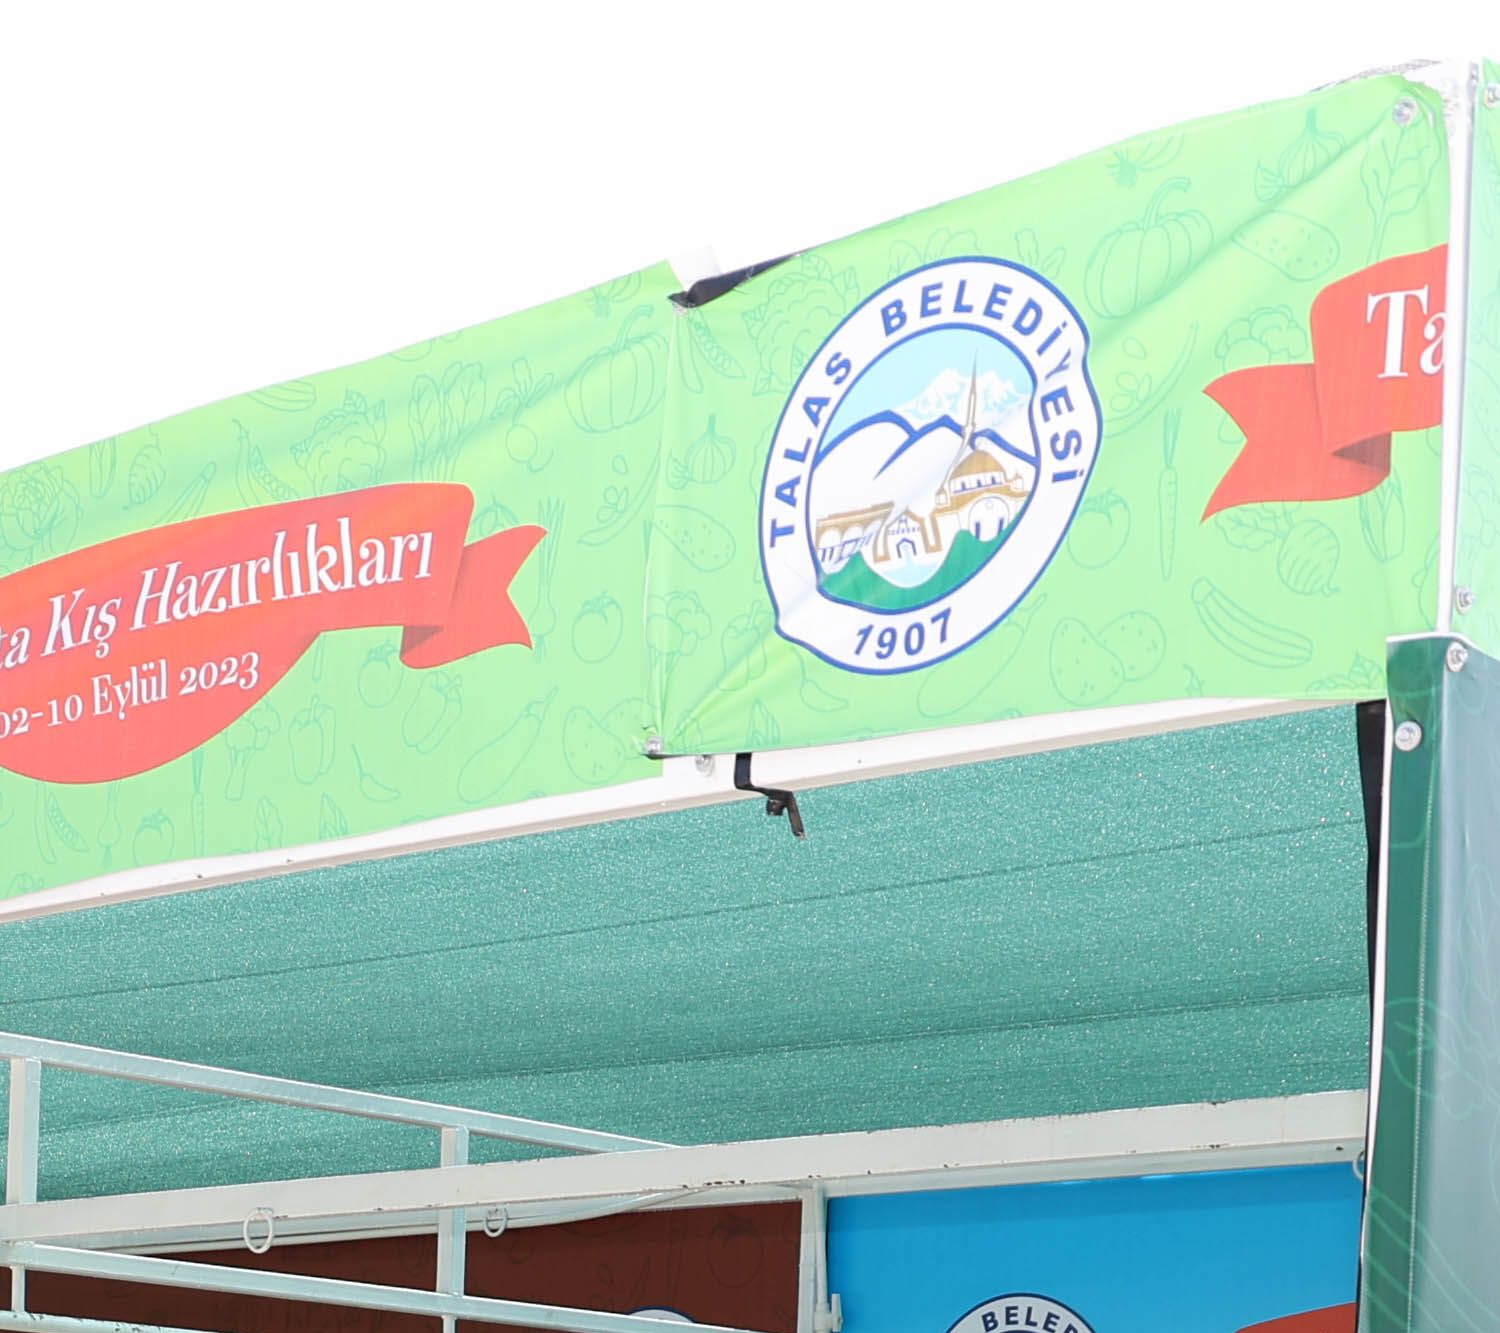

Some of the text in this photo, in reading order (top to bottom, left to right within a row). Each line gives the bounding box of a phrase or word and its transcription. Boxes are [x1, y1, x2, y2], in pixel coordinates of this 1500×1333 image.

[770, 278, 1086, 548] TALAS BELEDİYESİ
[41, 587, 123, 660] Kış
[130, 517, 433, 632] Hazırlıkları
[854, 608, 953, 661] 1907
[93, 660, 168, 728] Eylül
[179, 651, 262, 695] 2023
